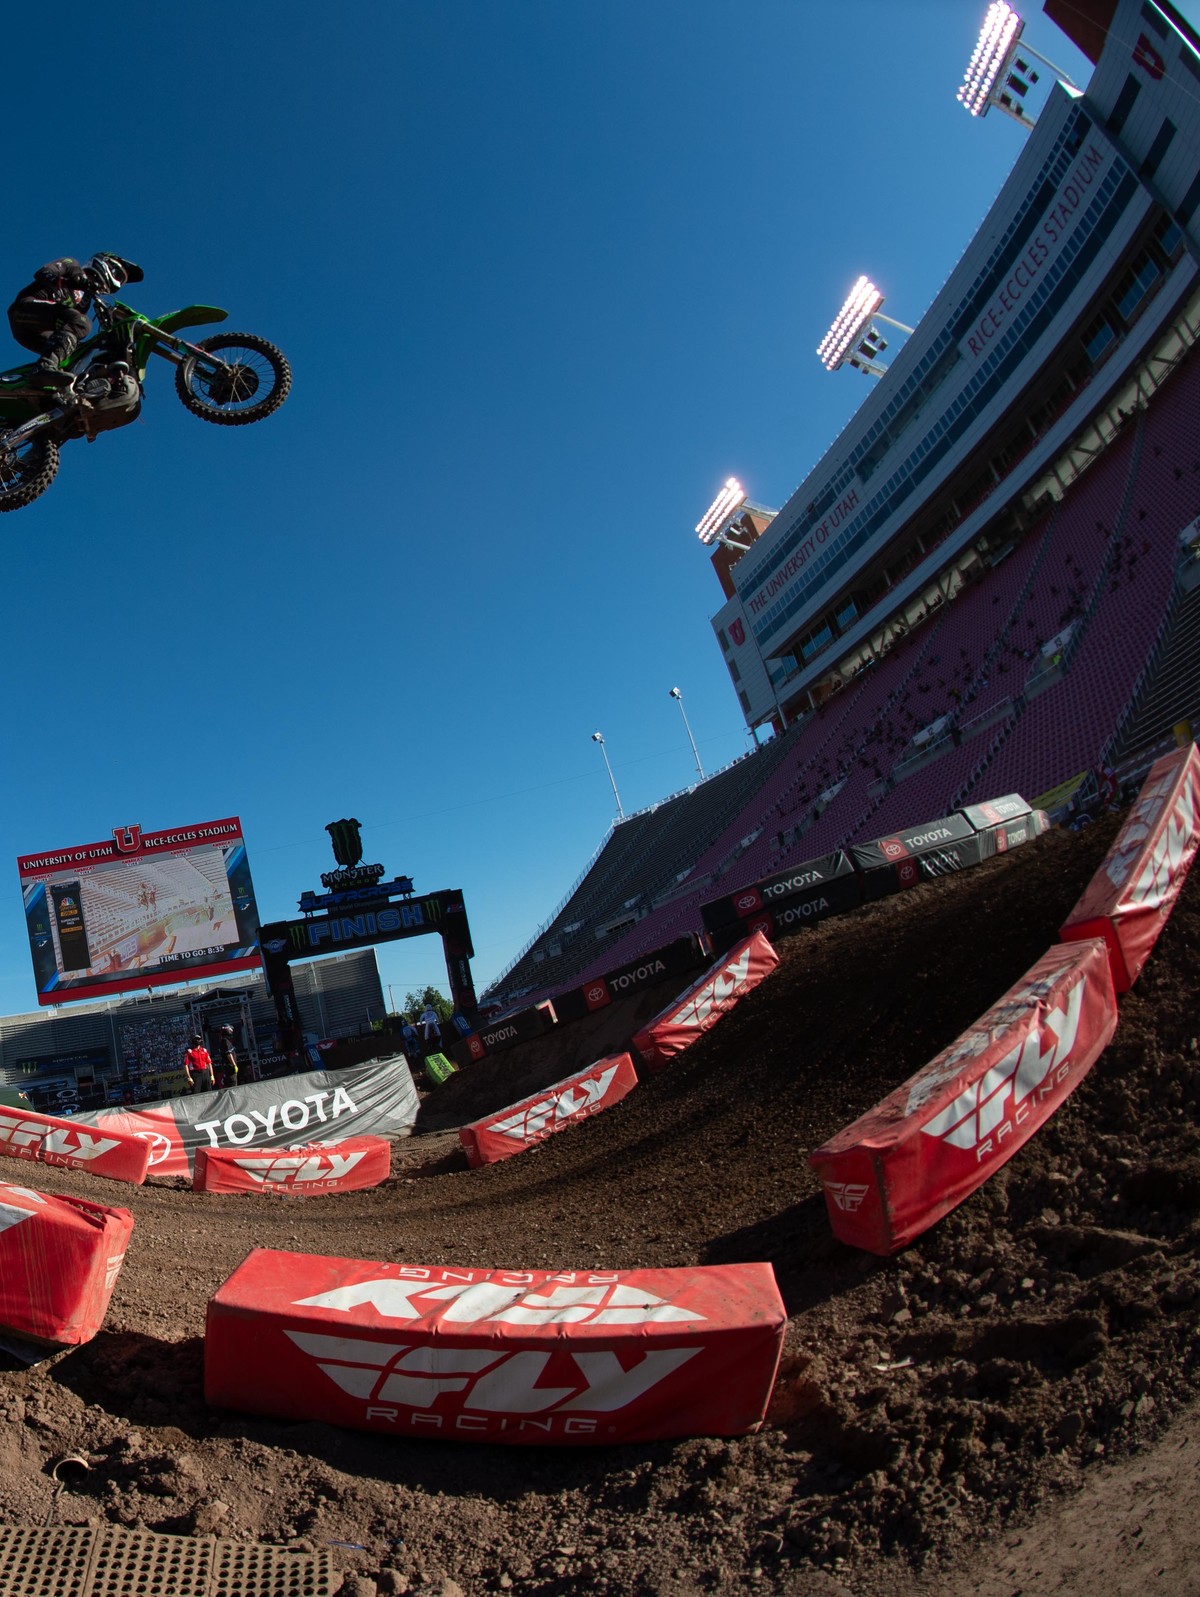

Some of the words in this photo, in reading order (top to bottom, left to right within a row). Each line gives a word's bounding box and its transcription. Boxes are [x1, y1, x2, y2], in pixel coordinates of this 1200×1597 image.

[968, 236, 1049, 357] RICE-ECCLES
[1044, 144, 1104, 243] STADIUM
[749, 596, 768, 615] THE
[767, 545, 817, 597] UNIVERSITY
[815, 527, 831, 545] OF
[830, 490, 860, 528] UTAH
[727, 617, 746, 646] U
[995, 801, 1021, 815] TOYOTA
[112, 823, 142, 852] U
[144, 831, 197, 848] RICE-ECCLES
[198, 823, 238, 838] STADIUM
[905, 827, 953, 849] TOYOTA
[1007, 828, 1027, 845] TOYOTA
[23, 852, 73, 870] UNIVERSITY
[75, 850, 88, 862] OF
[90, 846, 113, 858] UTAH
[322, 864, 383, 883] MONSTER
[763, 869, 824, 899] TOYOTA
[301, 880, 413, 909] SUPERCROSS
[307, 903, 424, 947] FINISH
[775, 897, 829, 926] TOYOTA
[160, 953, 179, 963] TIME
[180, 951, 191, 960] TO
[192, 949, 207, 957] GO:
[207, 945, 225, 955] 8:35
[609, 959, 666, 992] TOYOTA
[482, 1025, 518, 1046] TOYOTA
[920, 974, 1087, 1149] FLY
[485, 1063, 619, 1138] FLY
[976, 1061, 1070, 1162] RACING
[194, 1087, 359, 1149] TOYOTA
[523, 1102, 601, 1145] RACING
[4, 1144, 84, 1168] RACING
[233, 1151, 368, 1183] FLY
[261, 1179, 338, 1192] RACING
[398, 1266, 619, 1284] RACING
[282, 1330, 706, 1413] FLY
[365, 1406, 599, 1434] RACING
